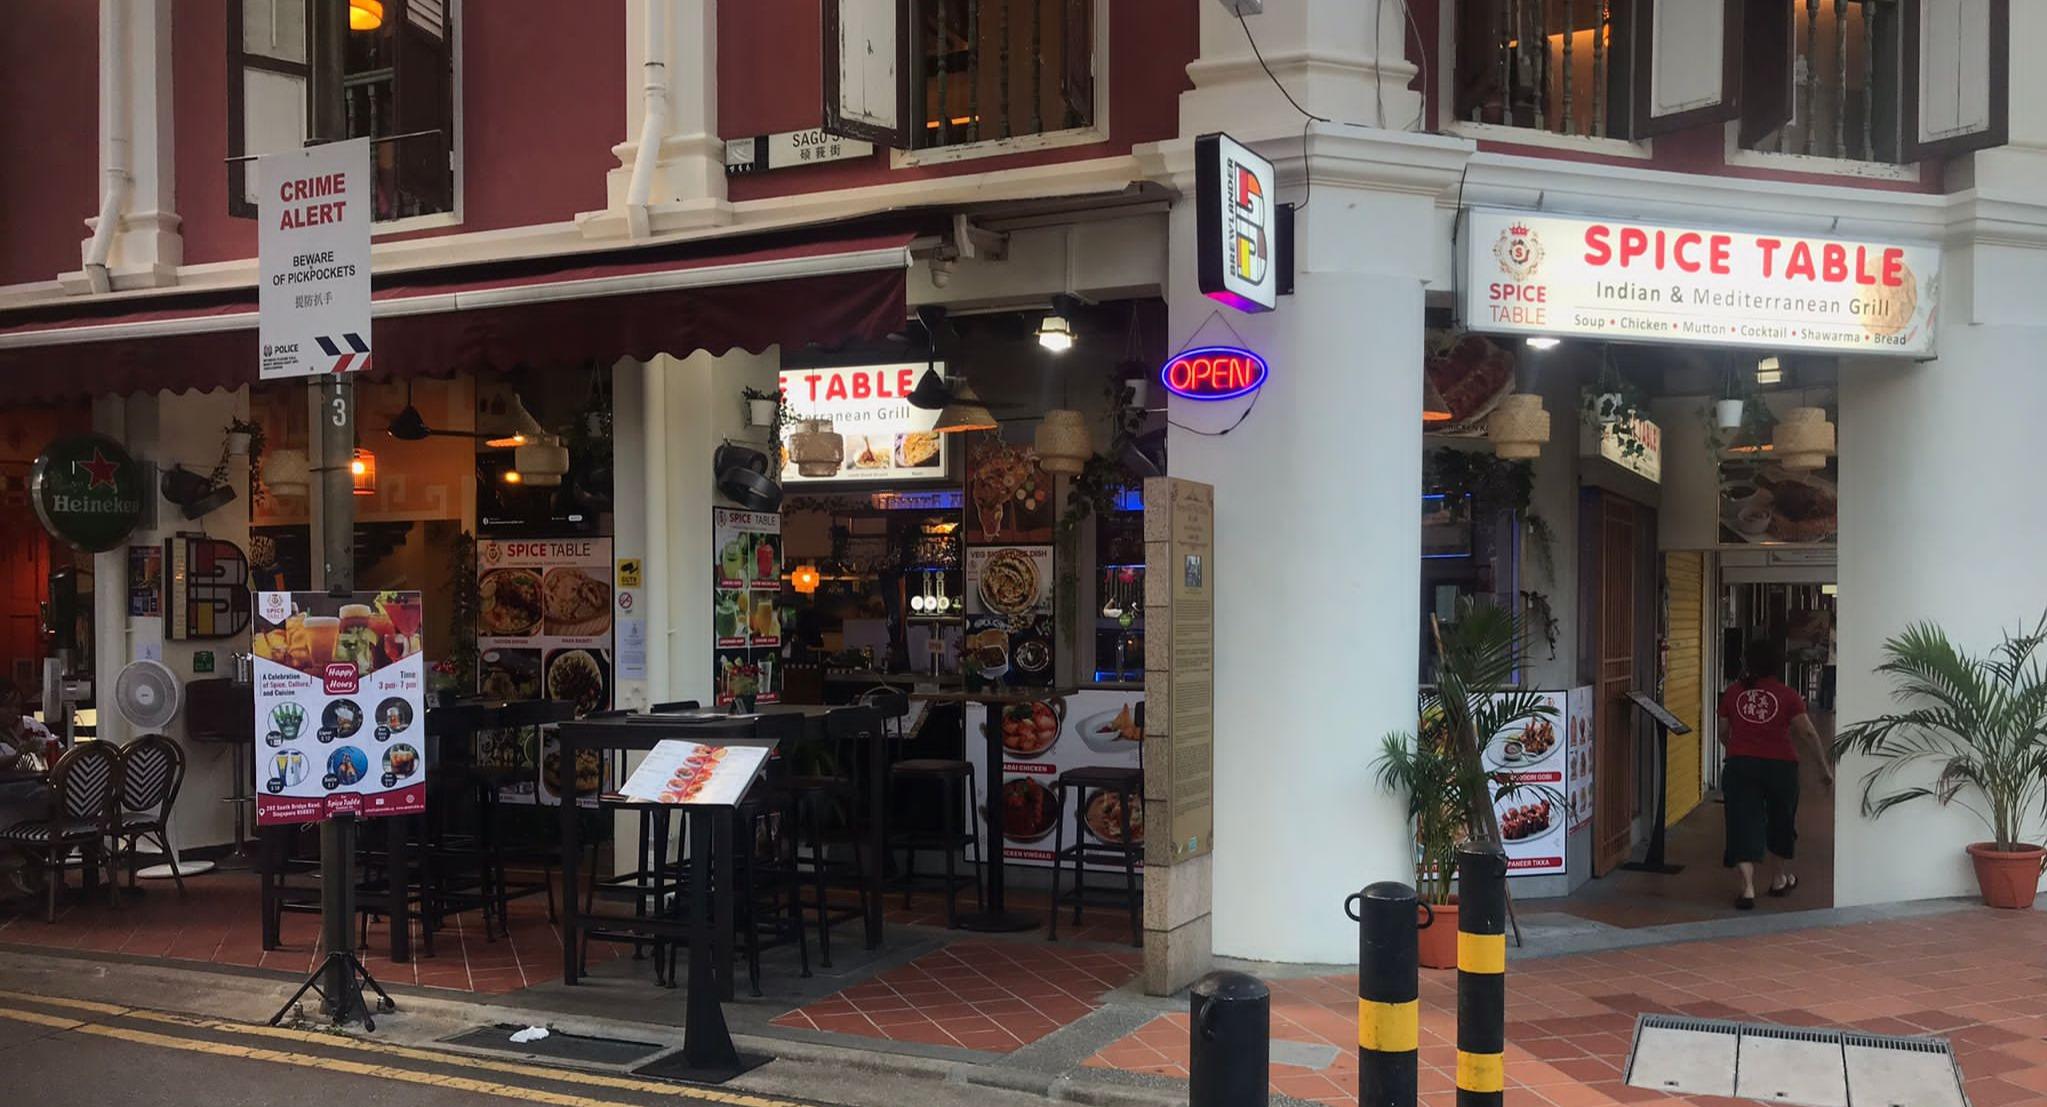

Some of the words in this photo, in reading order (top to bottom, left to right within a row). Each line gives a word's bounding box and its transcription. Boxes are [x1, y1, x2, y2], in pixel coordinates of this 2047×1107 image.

[792, 131, 828, 148] SAGO
[280, 172, 346, 203] CRIME
[279, 202, 347, 231] ALERT
[1226, 157, 1236, 277] BREWLANDER
[292, 251, 334, 268] BEWARE
[1584, 224, 1732, 275] SPICE
[1755, 238, 1905, 287] TABLE
[272, 272, 286, 287] OF
[287, 264, 356, 285] PICKPOCKETS
[1489, 282, 1547, 303] SPICE
[1596, 281, 1661, 302] Indian
[1670, 285, 1684, 304] &
[1693, 288, 1840, 314] Mediterranean
[1849, 298, 1890, 317] Grill
[1489, 304, 1546, 325] TABLE
[1574, 313, 1605, 328] Soup
[1620, 316, 1668, 331] Chicken
[1682, 321, 1726, 335] Mutton
[1740, 324, 1787, 339] Cocktail
[1800, 328, 1860, 343] Shawarma
[1873, 332, 1907, 345] Bread
[274, 343, 299, 356] POLICE
[804, 369, 914, 402] TABLE
[1169, 358, 1250, 391] OPEN
[877, 407, 911, 420] Grill
[53, 493, 141, 513] Heineken
[729, 513, 752, 524] SPICE
[754, 515, 776, 526] TABLE
[507, 543, 547, 557] SPICE
[549, 542, 591, 557] TABLE
